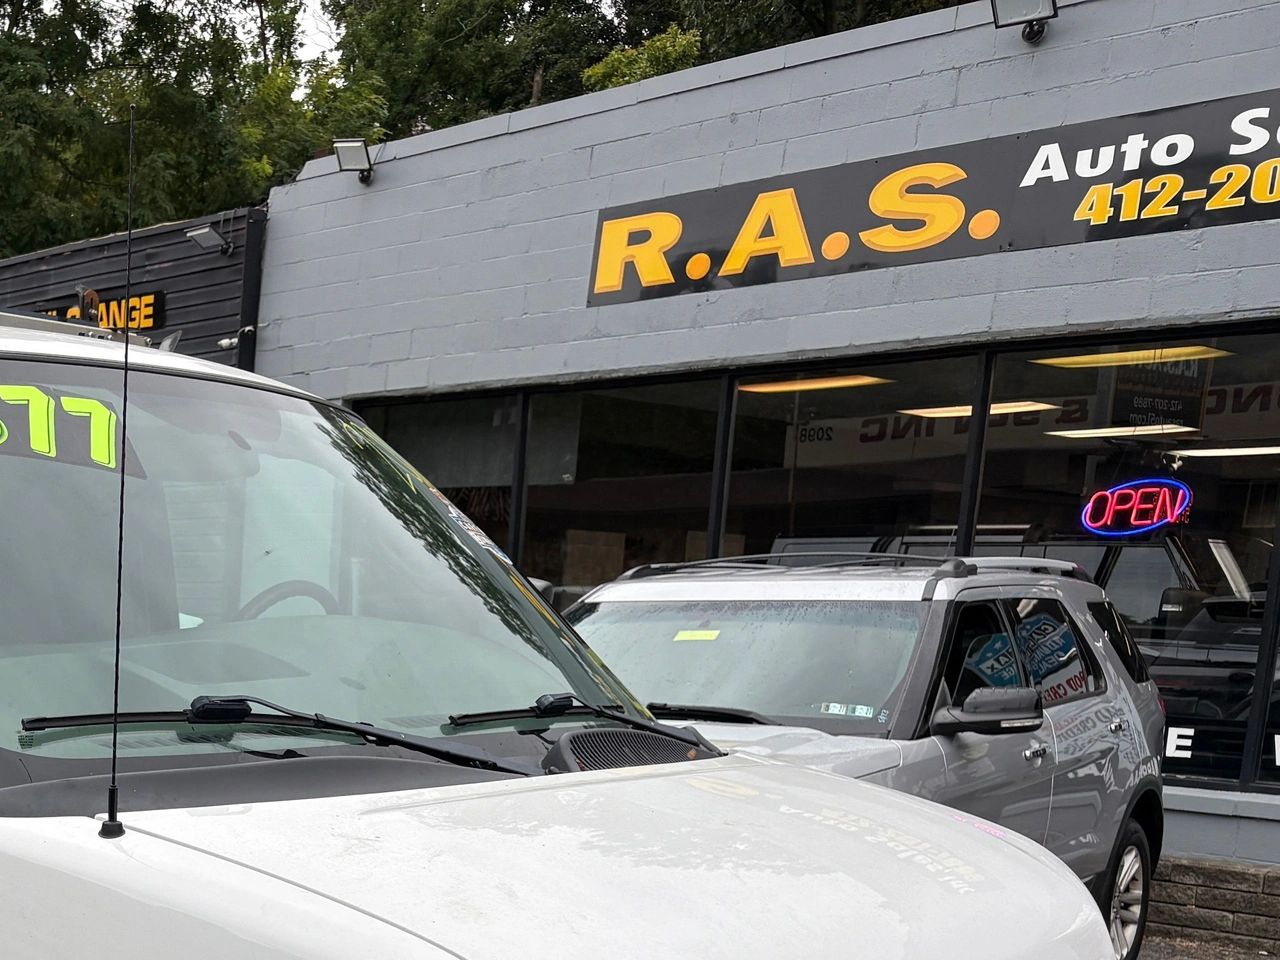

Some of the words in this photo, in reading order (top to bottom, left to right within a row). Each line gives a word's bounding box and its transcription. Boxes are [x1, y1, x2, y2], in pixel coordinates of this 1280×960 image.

[1020, 131, 1195, 188] Auto
[593, 162, 1000, 294] R.A.S.
[1085, 487, 1184, 528] OPEN
[1165, 727, 1195, 758] E
